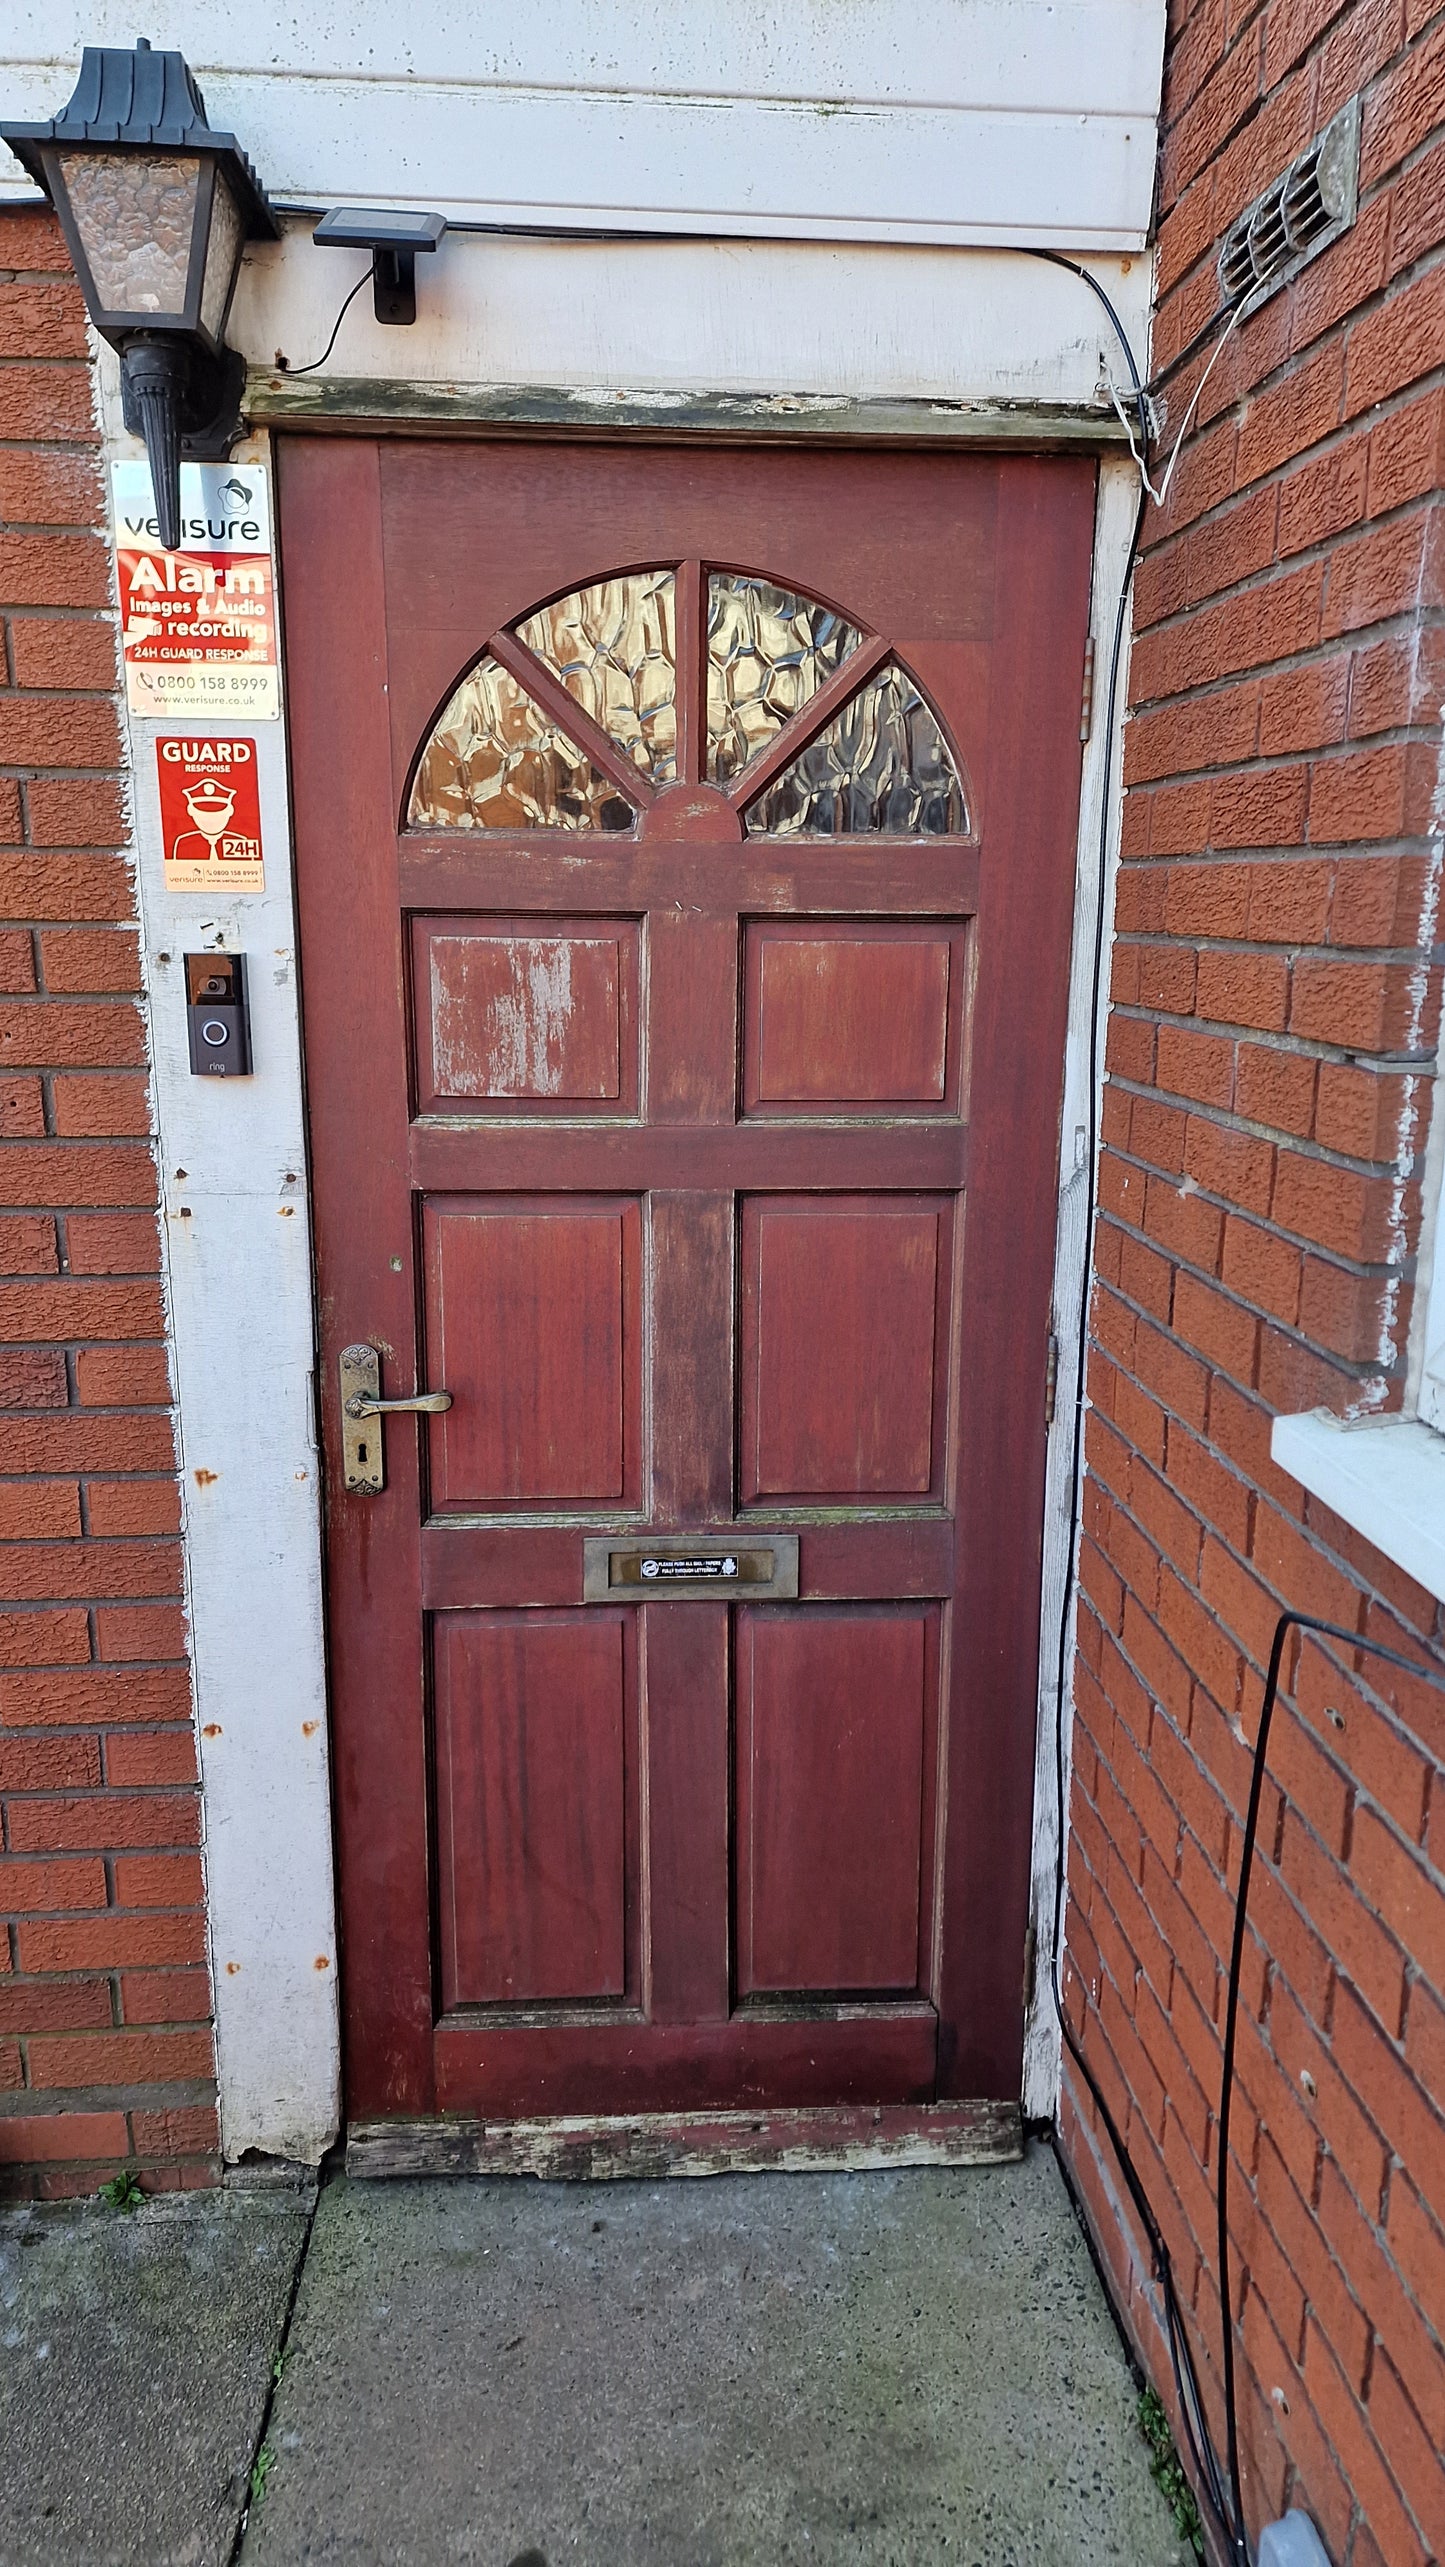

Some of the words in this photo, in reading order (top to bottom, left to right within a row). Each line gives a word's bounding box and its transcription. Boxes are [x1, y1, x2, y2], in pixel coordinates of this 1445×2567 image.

[124, 516, 260, 540] veisure
[128, 556, 265, 594] Alarm
[129, 596, 192, 617] Images
[195, 598, 210, 615] &
[213, 598, 266, 616] Audio
[167, 618, 268, 643] recording
[134, 646, 158, 659] 24H
[160, 647, 203, 660] GUARD
[205, 648, 268, 661] RESPONSE
[157, 675, 196, 689] 0800
[199, 676, 226, 690] 158
[230, 677, 268, 691] 8999
[153, 695, 256, 706] www.verisure.co.uk
[162, 741, 251, 763] GUARD
[184, 764, 231, 773] RESPONSE
[224, 841, 258, 856] 24H
[169, 876, 203, 884] verisure
[209, 1062, 225, 1072] ring
